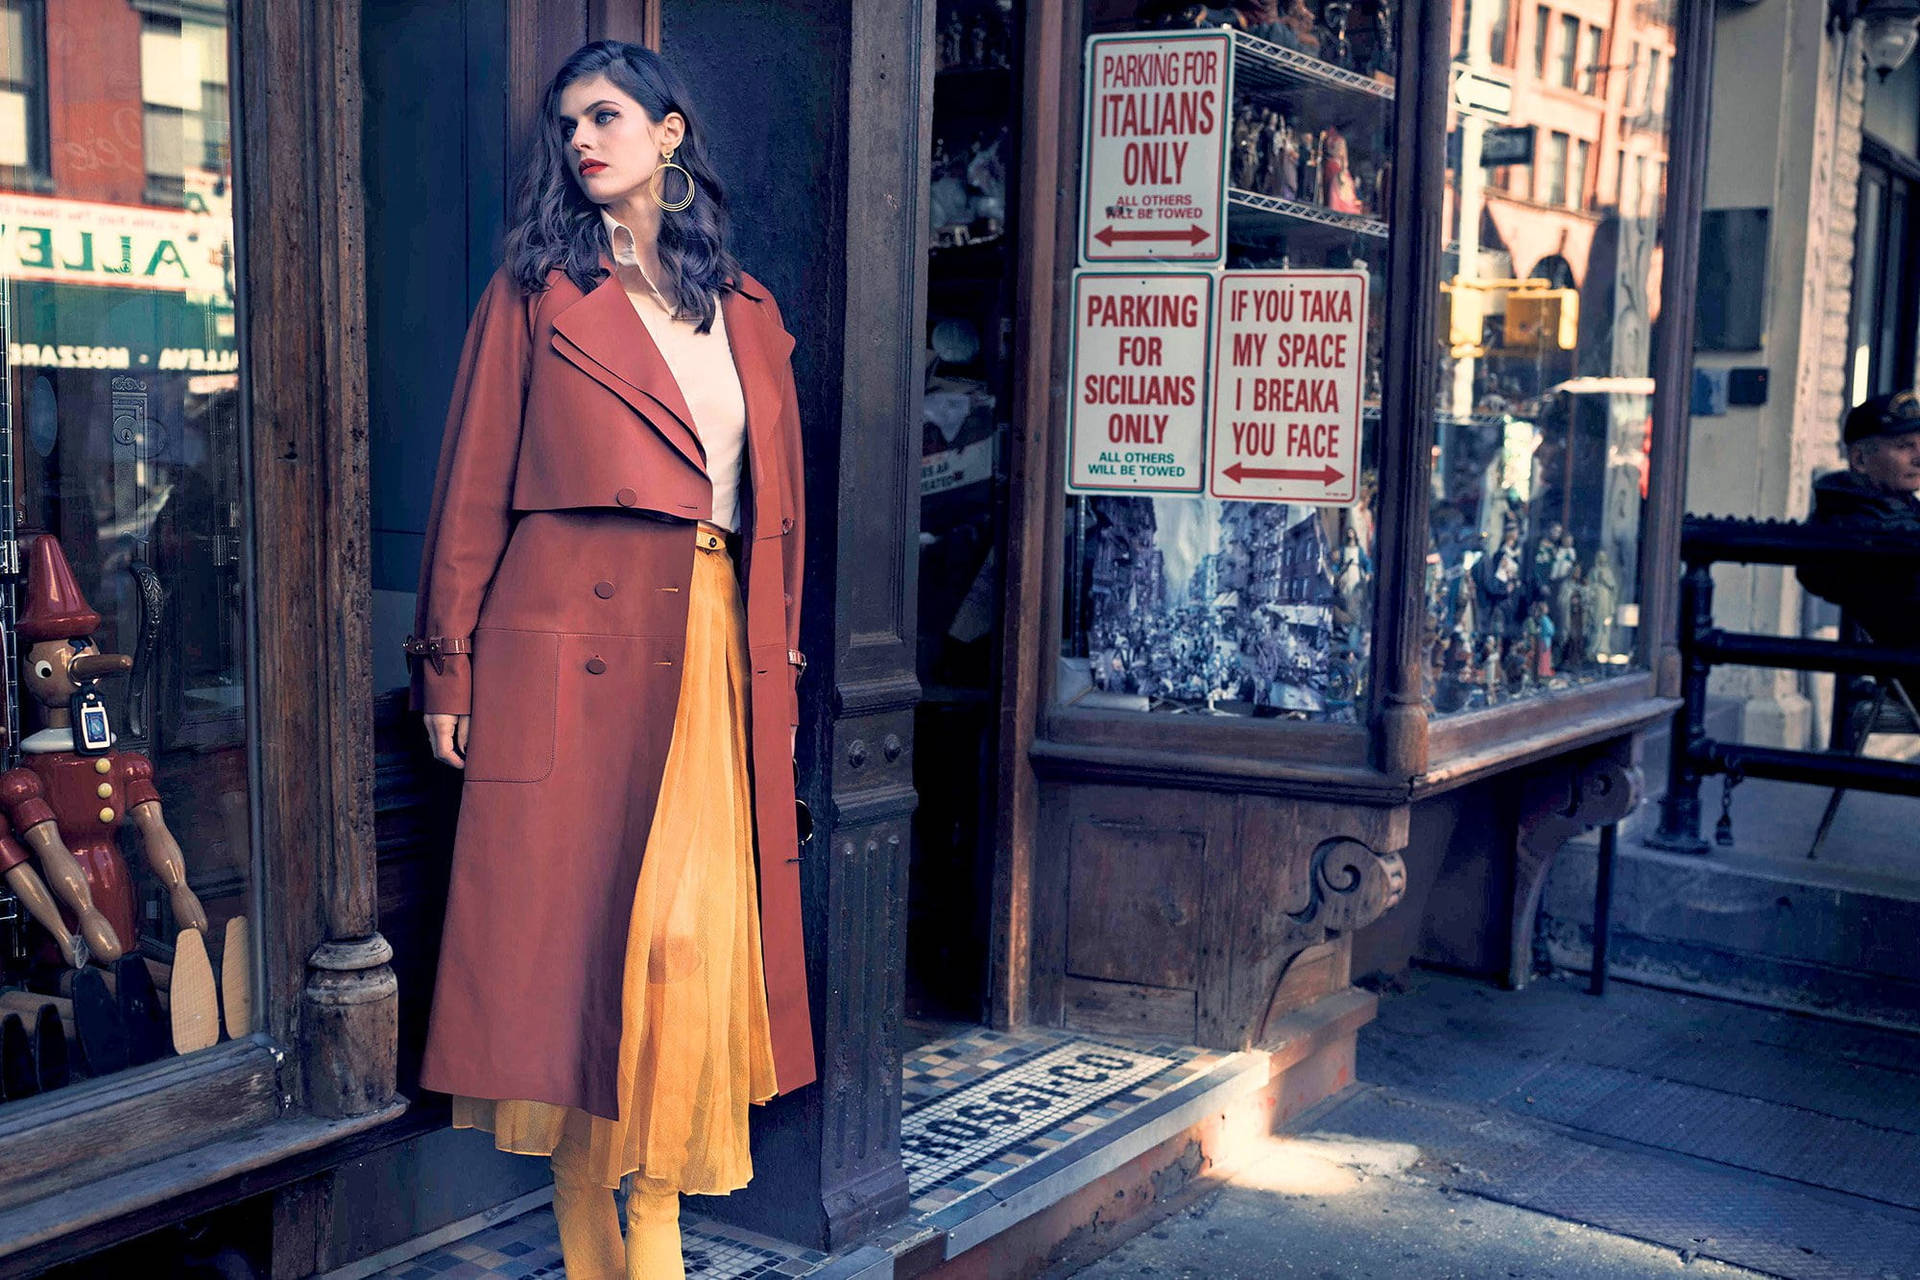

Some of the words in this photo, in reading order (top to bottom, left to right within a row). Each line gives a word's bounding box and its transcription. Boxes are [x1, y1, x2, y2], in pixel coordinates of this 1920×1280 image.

[1103, 53, 1179, 88] PARKING
[1184, 51, 1217, 85] FOR
[1101, 91, 1214, 137] ITALIANS
[1124, 142, 1188, 185] ONLY
[1116, 195, 1138, 206] ALL
[1142, 195, 1192, 206] OTHERS
[1138, 209, 1153, 219] BE
[1157, 208, 1202, 219] TOWED
[1088, 295, 1197, 327] PARKING
[1231, 290, 1248, 321] IF
[1254, 290, 1293, 322] YOU
[1300, 291, 1352, 322] TAKA
[1119, 337, 1162, 366] FOR
[1233, 333, 1267, 366] MY
[1278, 334, 1346, 368] SPACE
[1085, 375, 1195, 406] SICILIANS
[1235, 378, 1242, 411] I
[1254, 378, 1338, 413] BREAKA
[1109, 414, 1168, 444] ONLY
[1233, 422, 1274, 456] YOU
[1287, 424, 1339, 458] FACE
[1088, 464, 1116, 475] WILL
[1120, 465, 1135, 475] BE
[1140, 466, 1185, 477] TOWED
[1099, 452, 1120, 462] ALL
[1124, 453, 1174, 464] OTHERS
